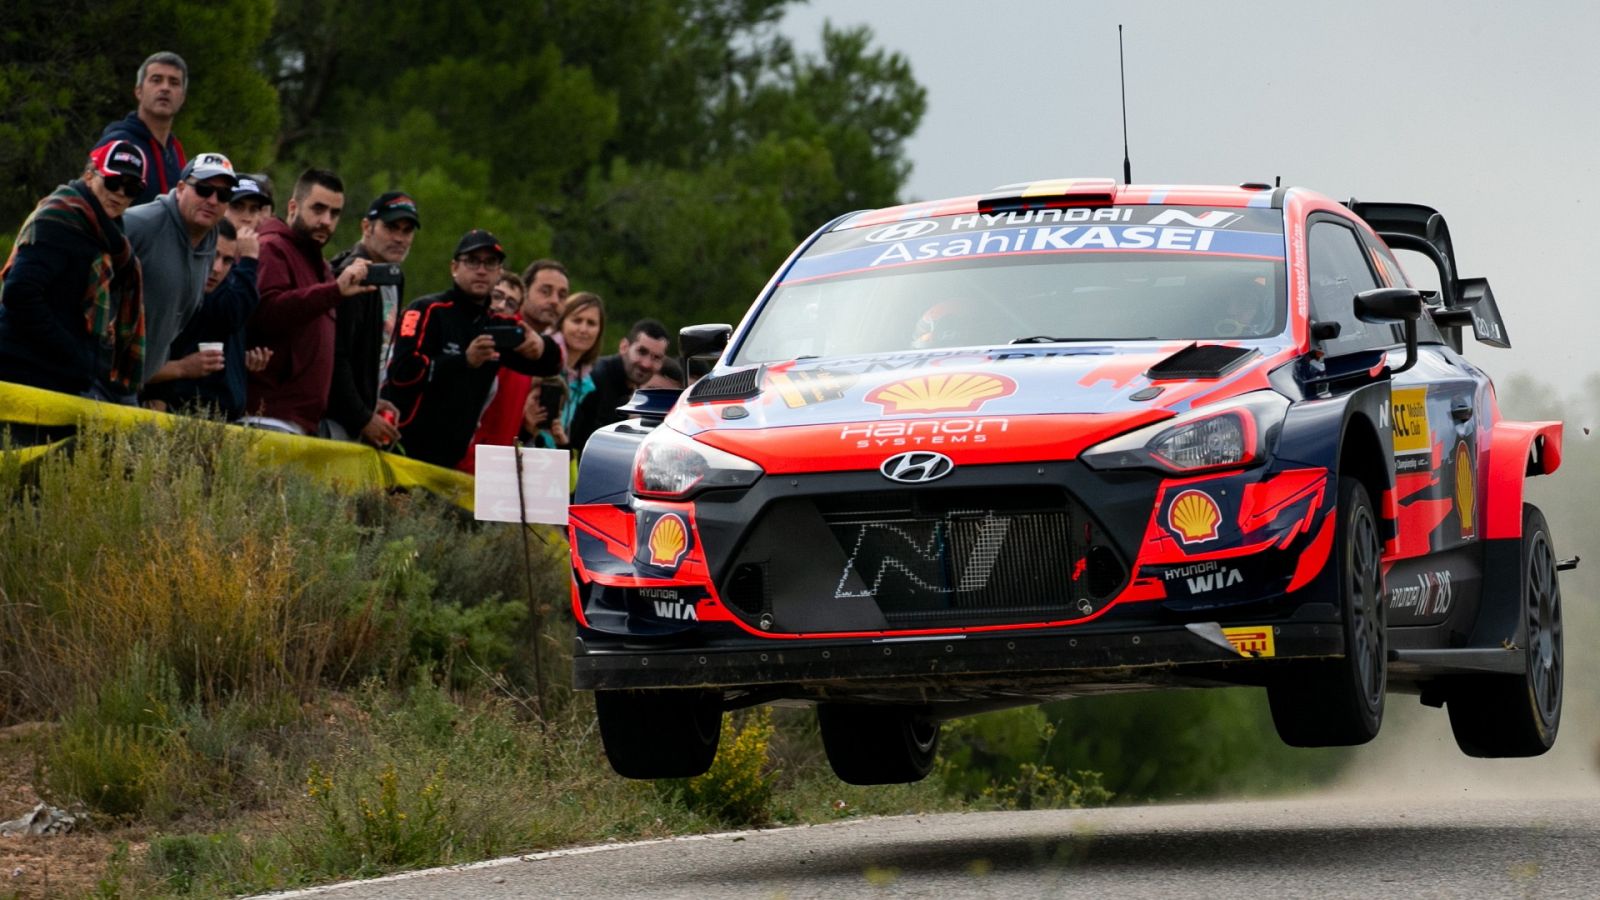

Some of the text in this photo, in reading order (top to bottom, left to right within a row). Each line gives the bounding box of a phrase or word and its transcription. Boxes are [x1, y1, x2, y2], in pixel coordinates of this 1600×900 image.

[951, 208, 1132, 230] HYUNDAI
[870, 226, 1215, 266] Asahi KASEI
[856, 434, 987, 448] SYSTEMS
[1165, 561, 1218, 580] HYUNDAI
[639, 588, 679, 600] HYUNDAI
